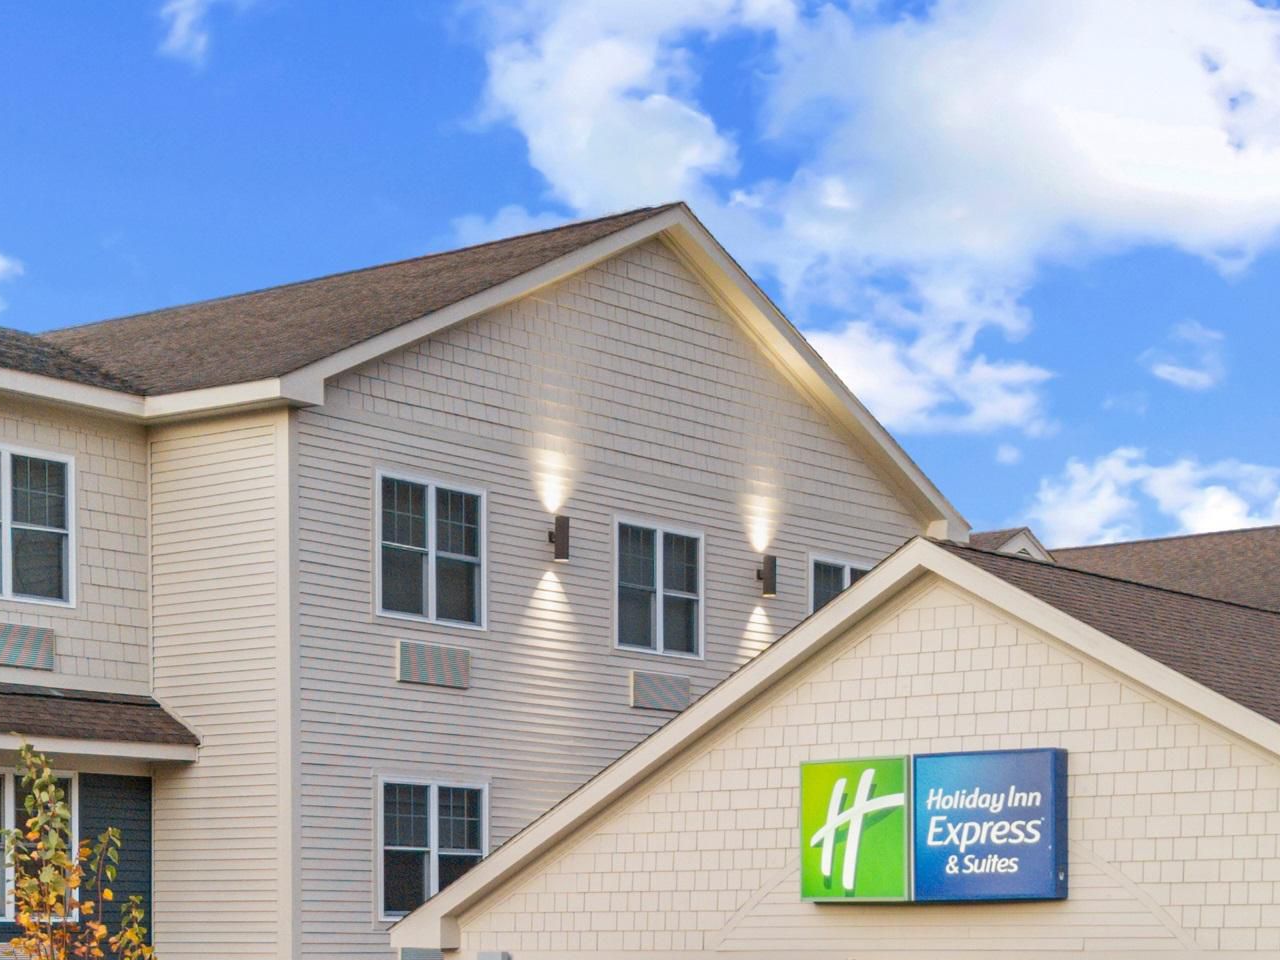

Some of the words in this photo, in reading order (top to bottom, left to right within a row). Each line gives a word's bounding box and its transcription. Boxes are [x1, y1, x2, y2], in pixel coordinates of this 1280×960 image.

[926, 787, 1005, 813] Holiday
[1007, 785, 1042, 807] Inn
[927, 815, 1042, 853] Express
[945, 855, 960, 874] &
[961, 854, 1019, 874] Suites
